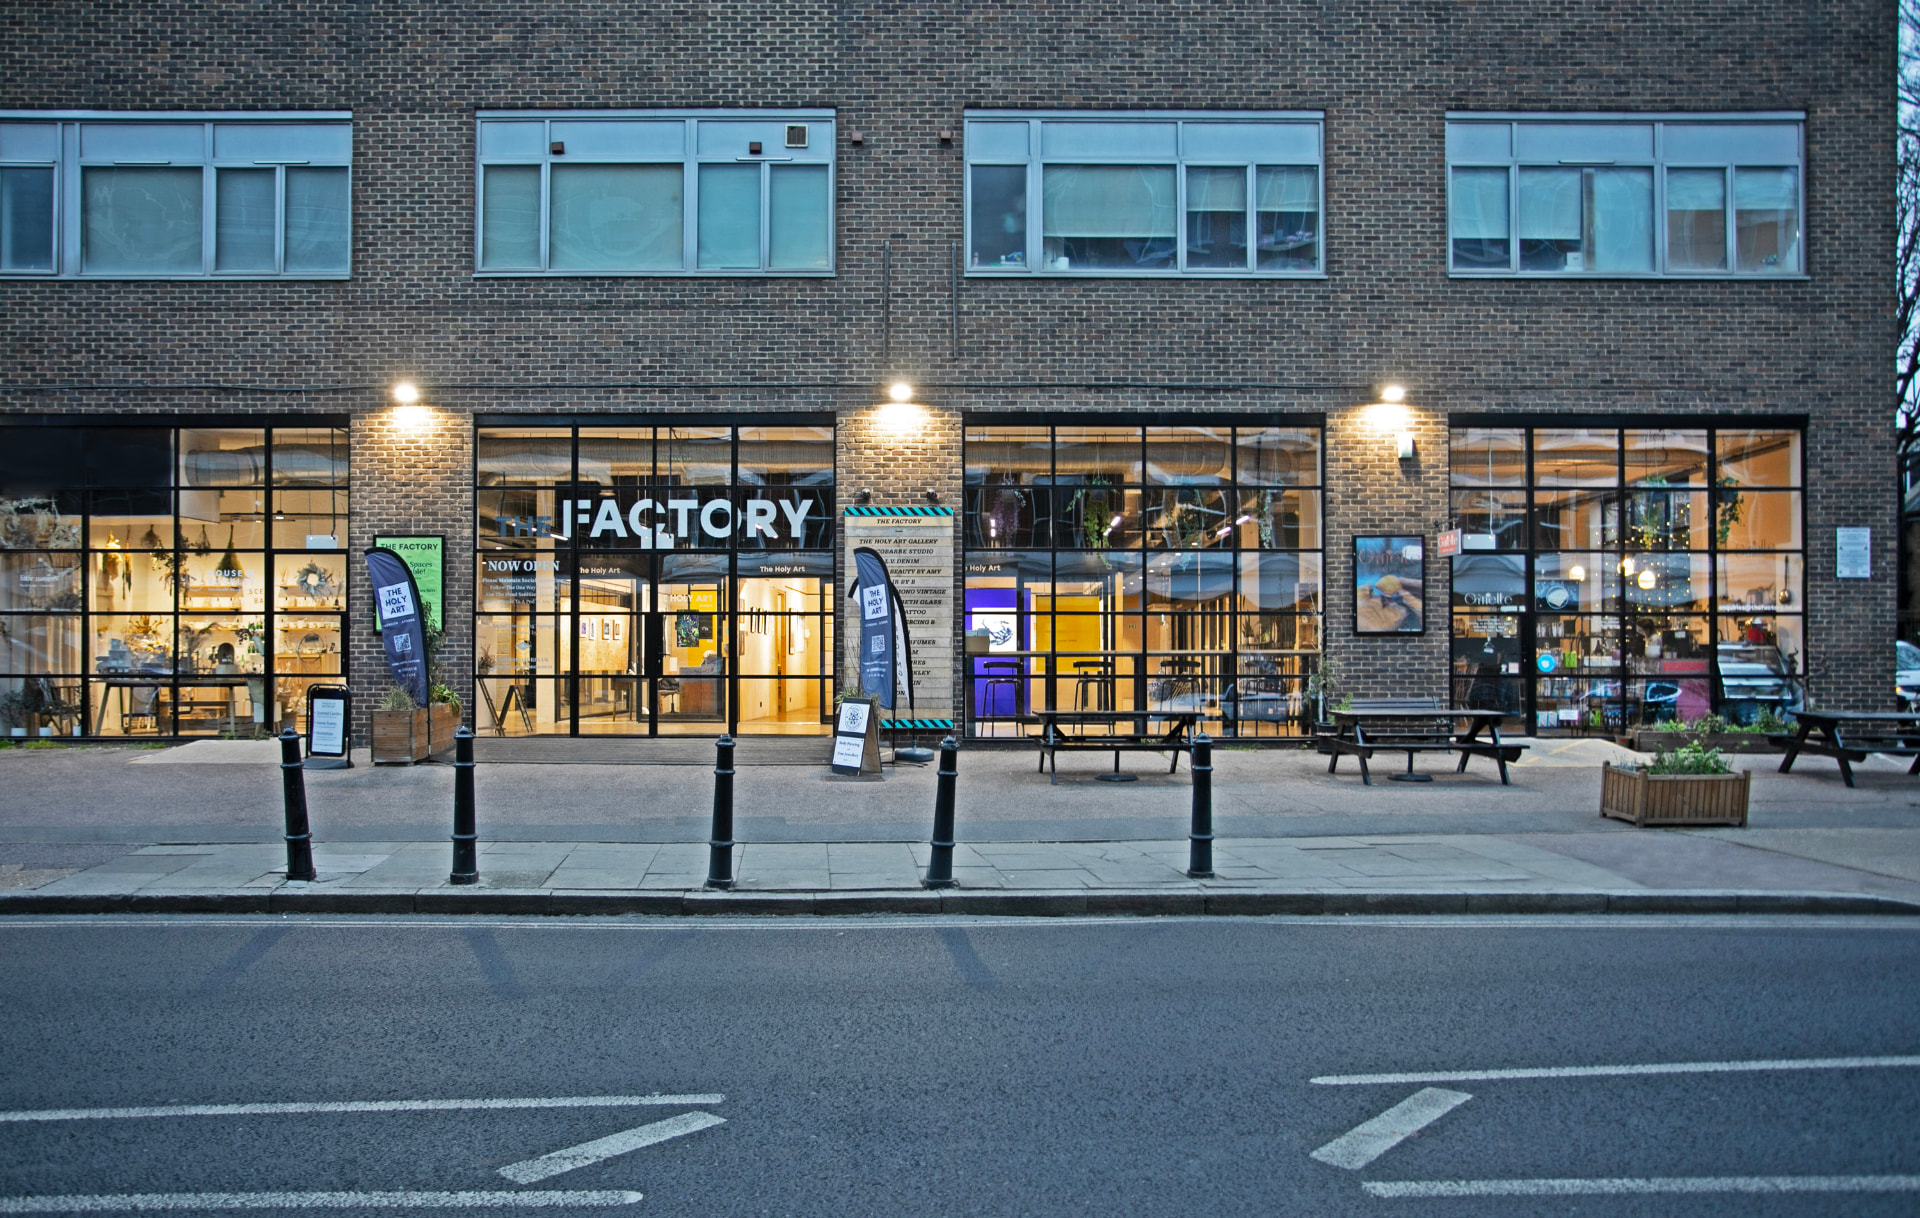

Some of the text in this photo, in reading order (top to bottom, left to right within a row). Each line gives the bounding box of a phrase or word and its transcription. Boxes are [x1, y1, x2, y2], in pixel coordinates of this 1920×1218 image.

[495, 498, 814, 539] THE FACTORY
[398, 543, 439, 551] FACTORY
[409, 561, 432, 569] Spaces
[488, 560, 560, 572] NOW OPEN
[774, 565, 791, 574] Holy
[970, 564, 987, 573] Holy
[207, 569, 243, 577] HOUSE
[579, 566, 590, 574] he
[590, 567, 607, 575] Holy
[386, 587, 402, 597] THE
[869, 588, 880, 597] THE
[385, 595, 407, 607] HOLY
[670, 594, 693, 602] HOLY
[695, 594, 713, 602] ART
[867, 597, 884, 607] HOLY
[390, 604, 406, 615] ART
[871, 606, 882, 615] ART
